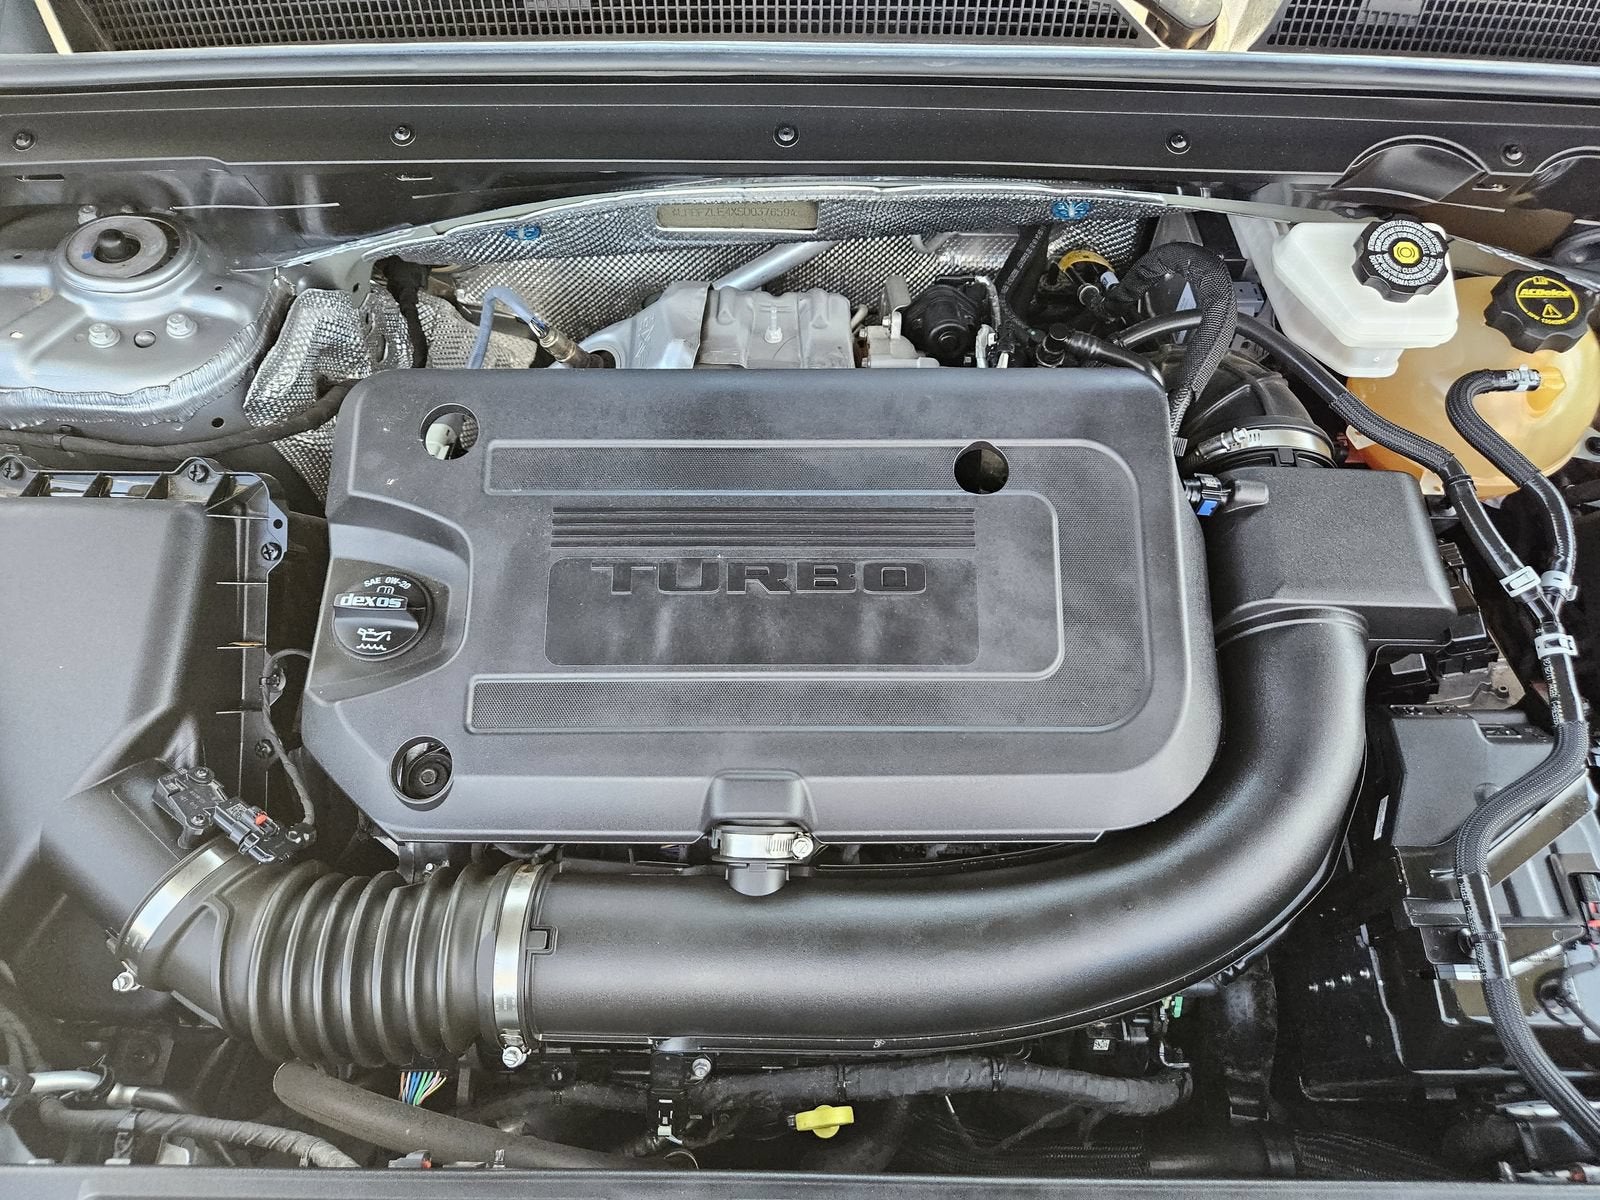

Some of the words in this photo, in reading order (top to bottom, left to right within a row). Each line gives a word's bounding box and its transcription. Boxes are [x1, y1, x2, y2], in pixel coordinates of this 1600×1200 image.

[1368, 255, 1378, 265] DOT
[1375, 266, 1389, 279] FLUID
[1388, 275, 1404, 286] FROM
[363, 577, 382, 588] SAE
[384, 576, 412, 590] 0W-20
[591, 561, 927, 595] TURBO
[340, 593, 405, 608] dexos
